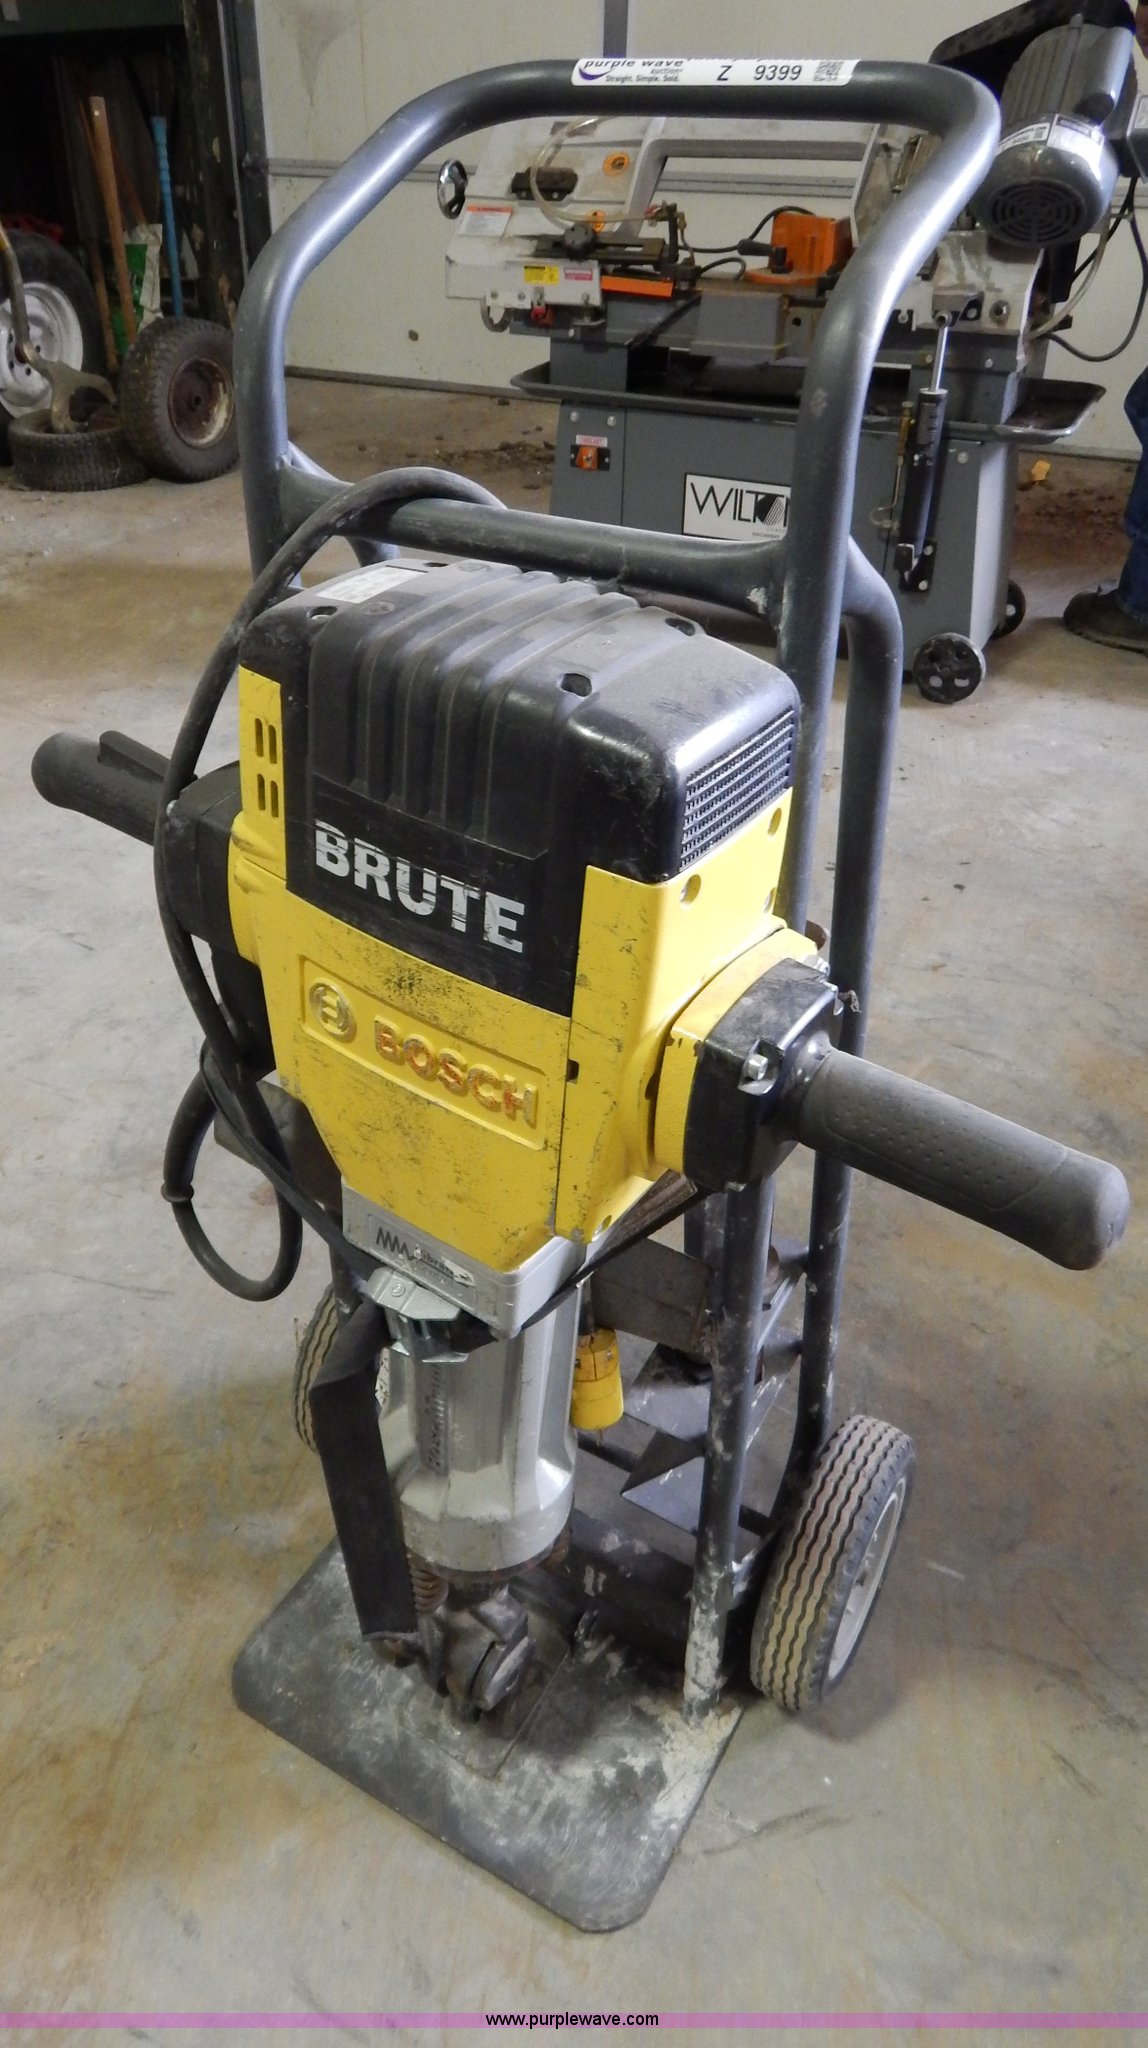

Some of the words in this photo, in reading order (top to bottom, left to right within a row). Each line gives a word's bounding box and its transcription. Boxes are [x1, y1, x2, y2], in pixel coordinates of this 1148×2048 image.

[584, 59, 635, 69] purple
[717, 64, 732, 81] Z
[754, 64, 803, 81] 9399
[315, 818, 526, 953] BRUTE
[374, 1014, 538, 1130] BOSCH
